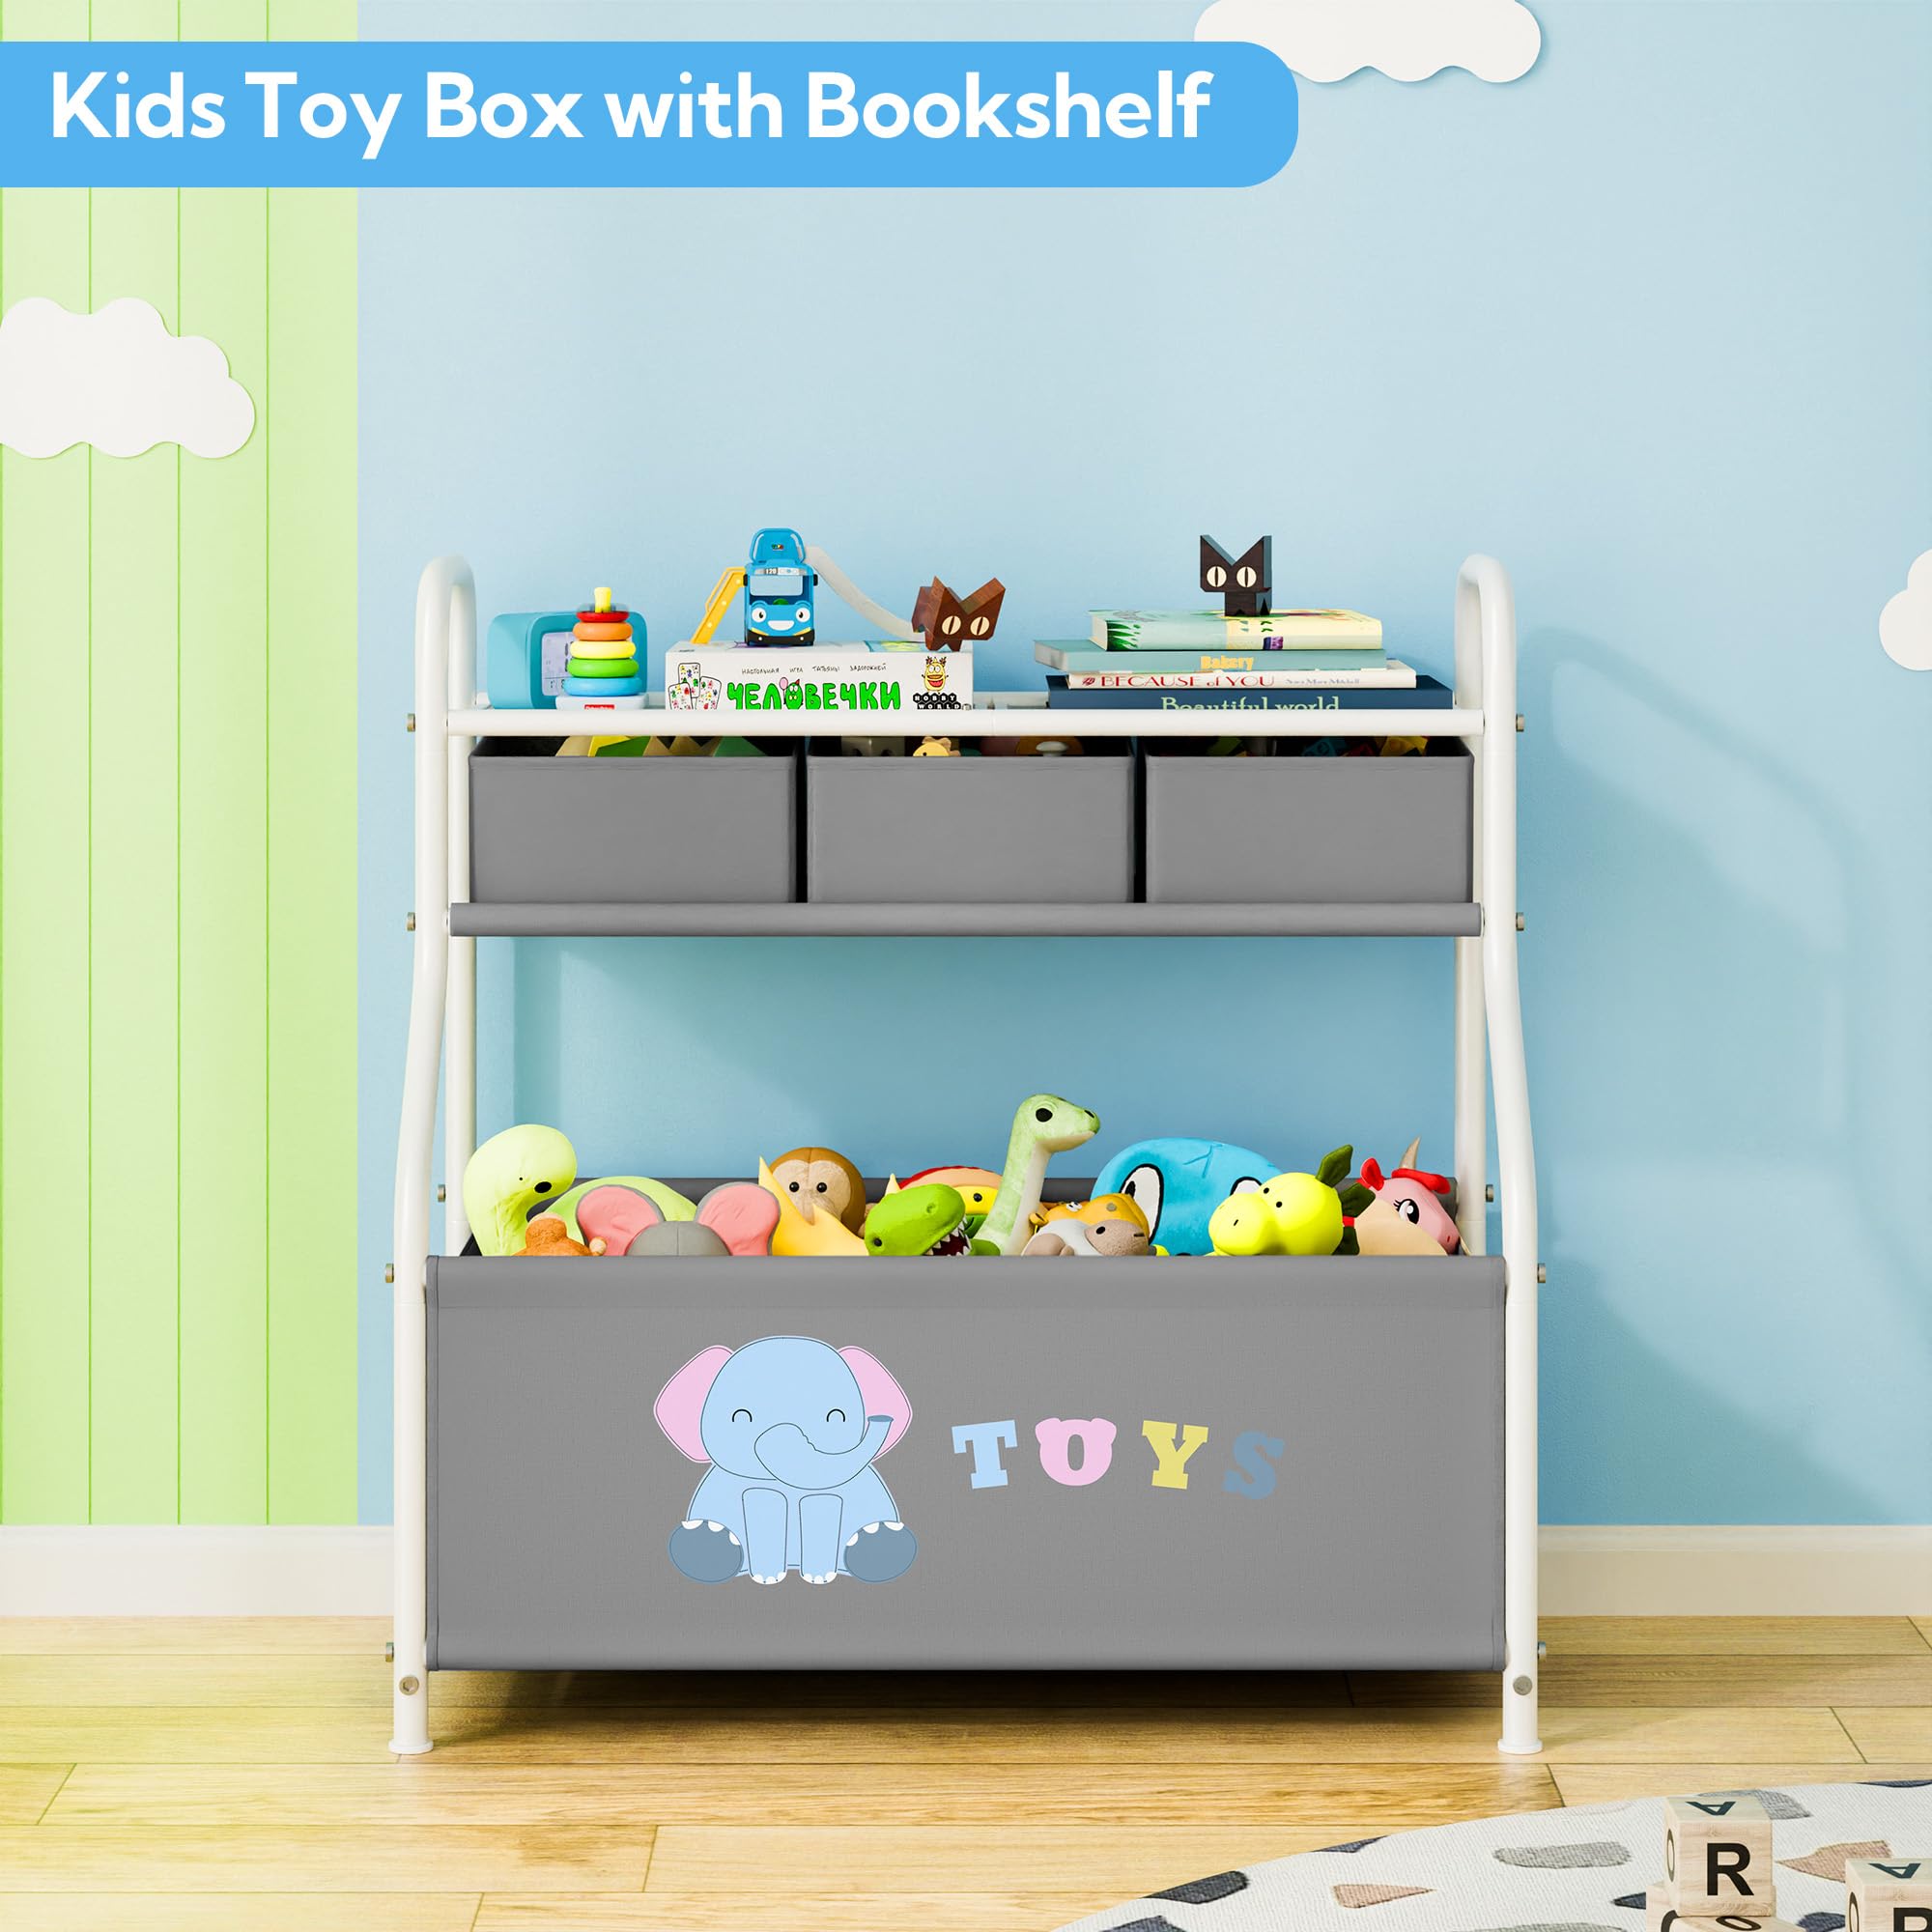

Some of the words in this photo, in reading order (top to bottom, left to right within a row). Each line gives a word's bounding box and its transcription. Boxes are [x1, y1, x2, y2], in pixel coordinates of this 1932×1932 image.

[1200, 655, 1254, 671] Bakery
[1101, 675, 1199, 687] BECAUSE
[1226, 675, 1275, 687] YOU
[914, 694, 955, 702] HOBBY
[952, 1417, 1286, 1500] TOYS
[1707, 1843, 1754, 1896] R
